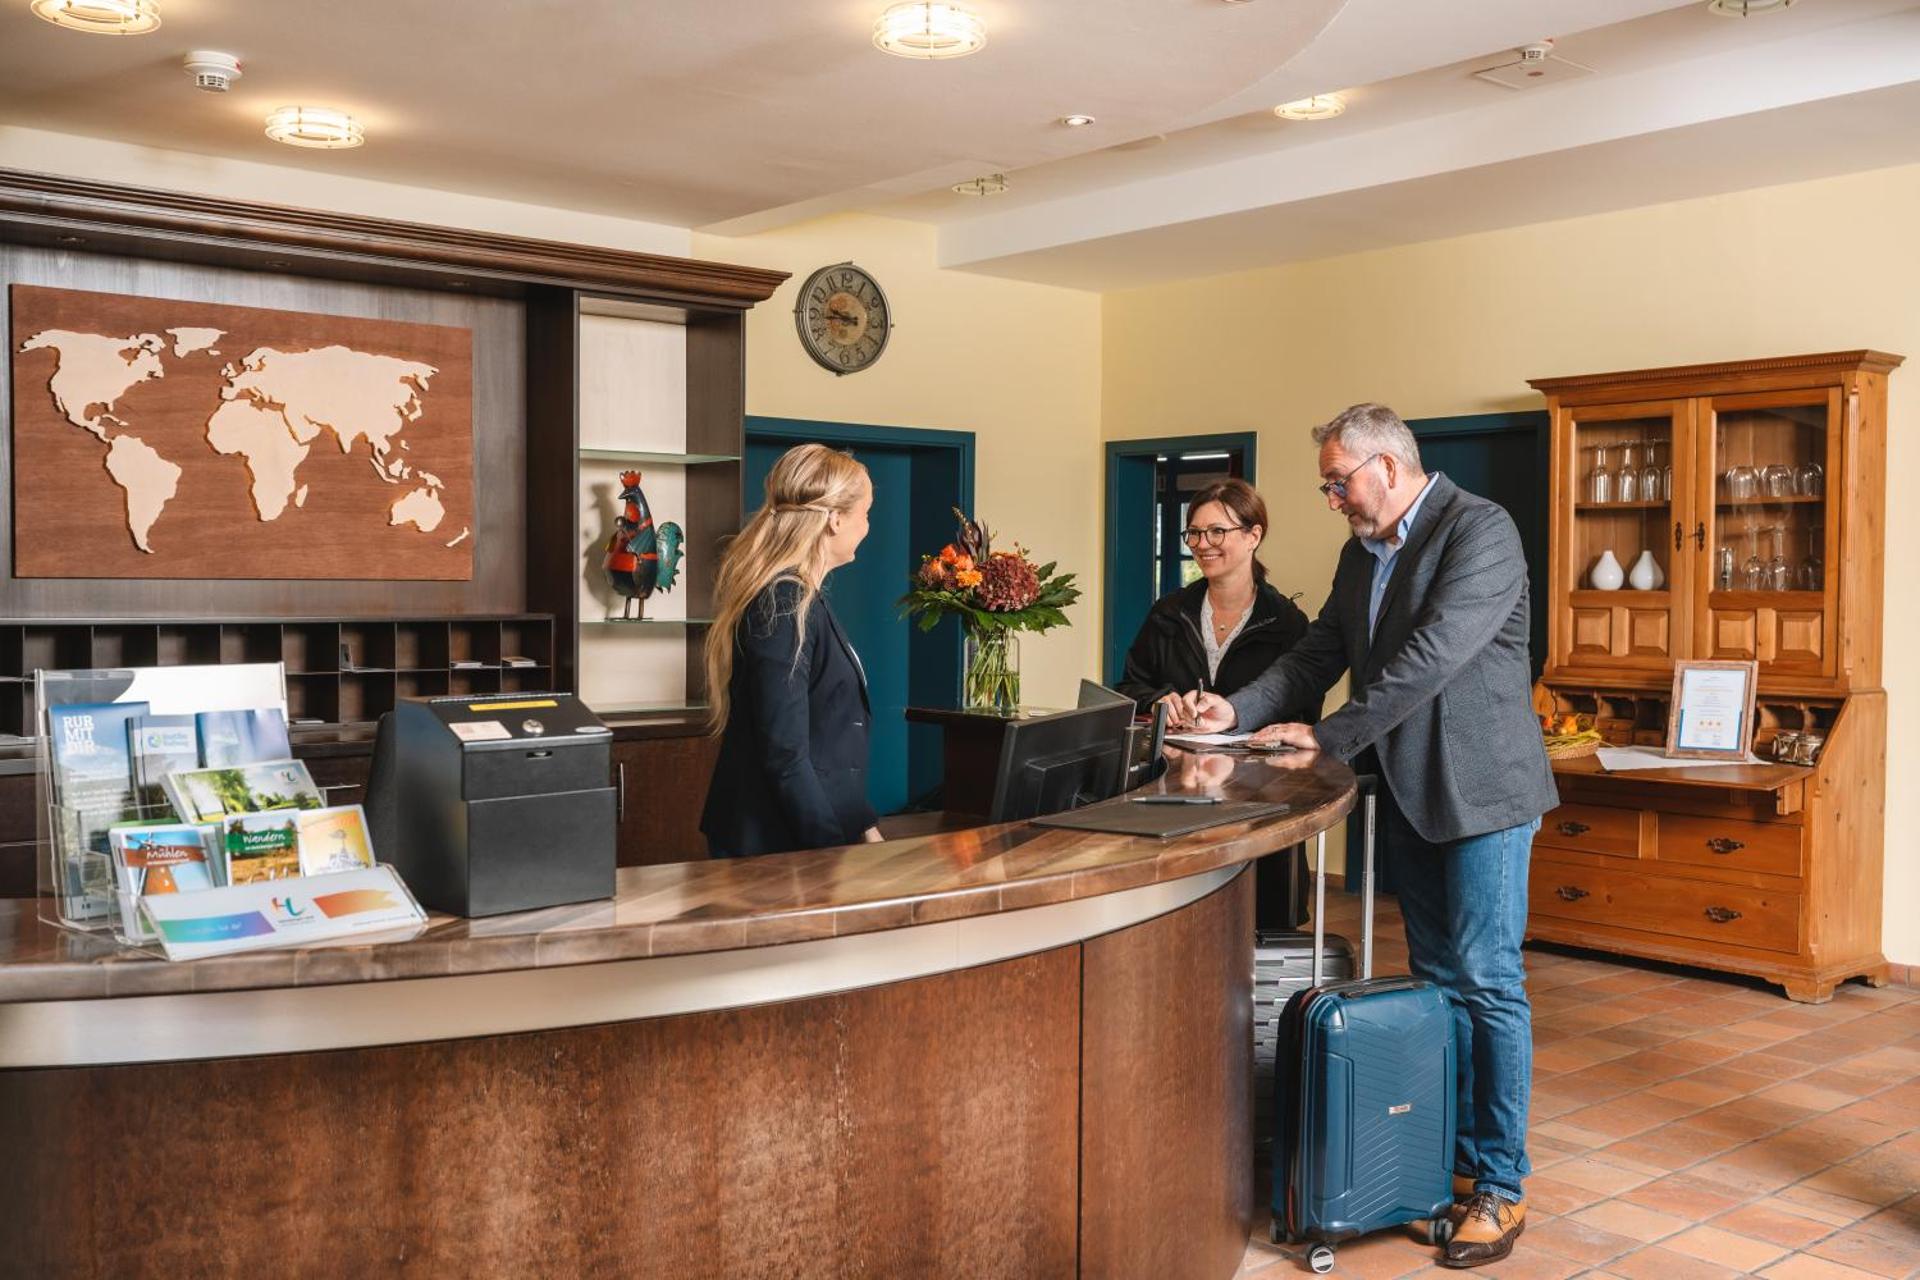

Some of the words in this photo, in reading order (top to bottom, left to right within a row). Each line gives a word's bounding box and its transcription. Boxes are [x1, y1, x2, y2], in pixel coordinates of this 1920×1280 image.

[63, 715, 94, 730] RUR
[64, 728, 93, 743] MIT
[67, 741, 97, 755] DIR
[243, 831, 286, 844] Wandern
[147, 847, 188, 860] Mühlen
